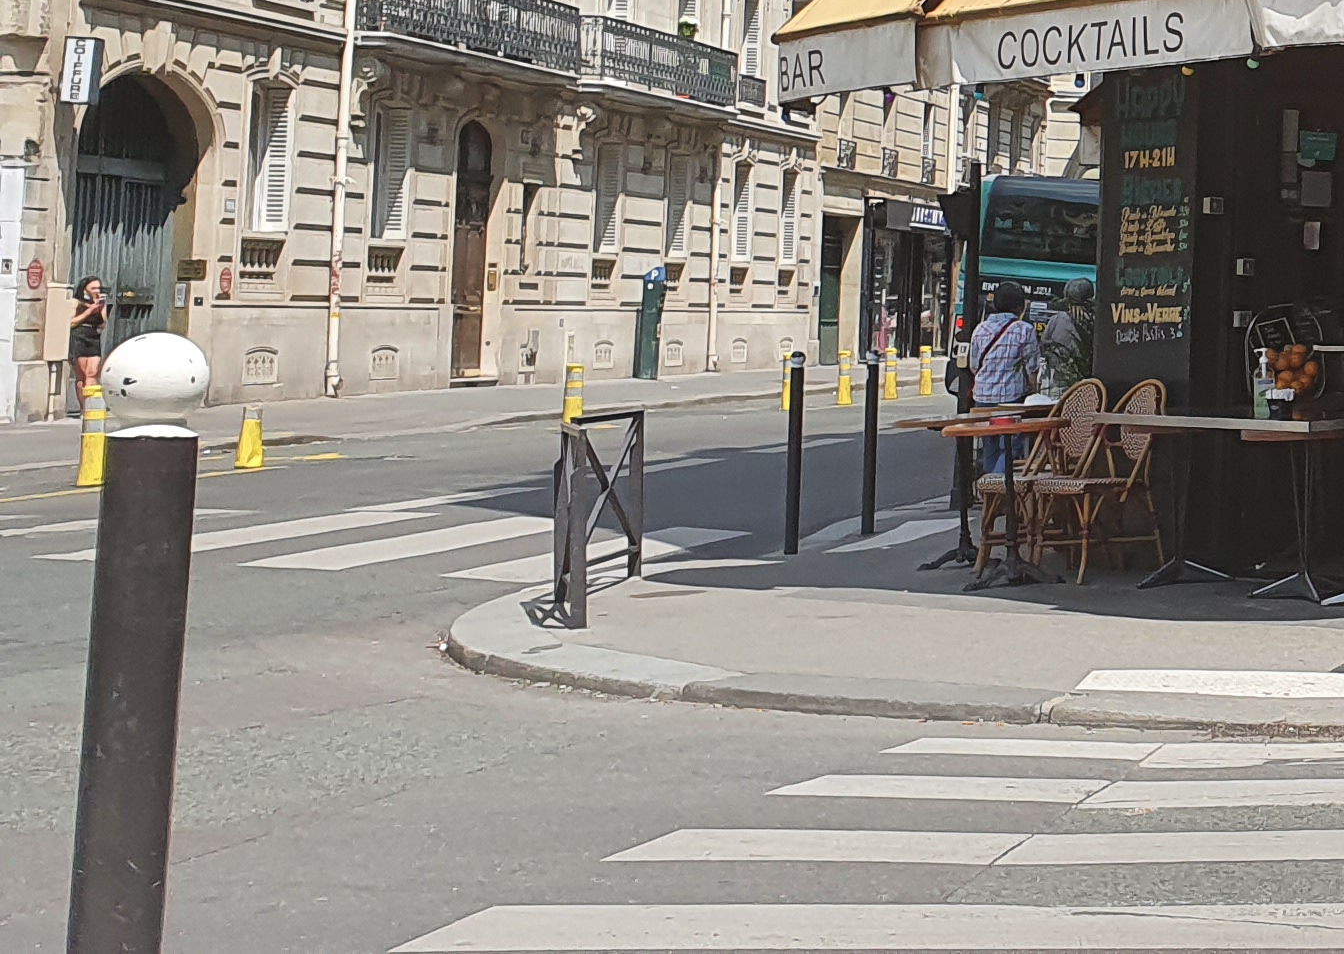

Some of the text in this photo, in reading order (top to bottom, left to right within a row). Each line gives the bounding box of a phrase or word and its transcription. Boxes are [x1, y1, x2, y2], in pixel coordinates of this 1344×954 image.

[998, 11, 1185, 70] COCKTAILS
[70, 39, 86, 100] COIFFURE
[779, 49, 825, 93] BAR
[1110, 302, 1141, 325] VINS
